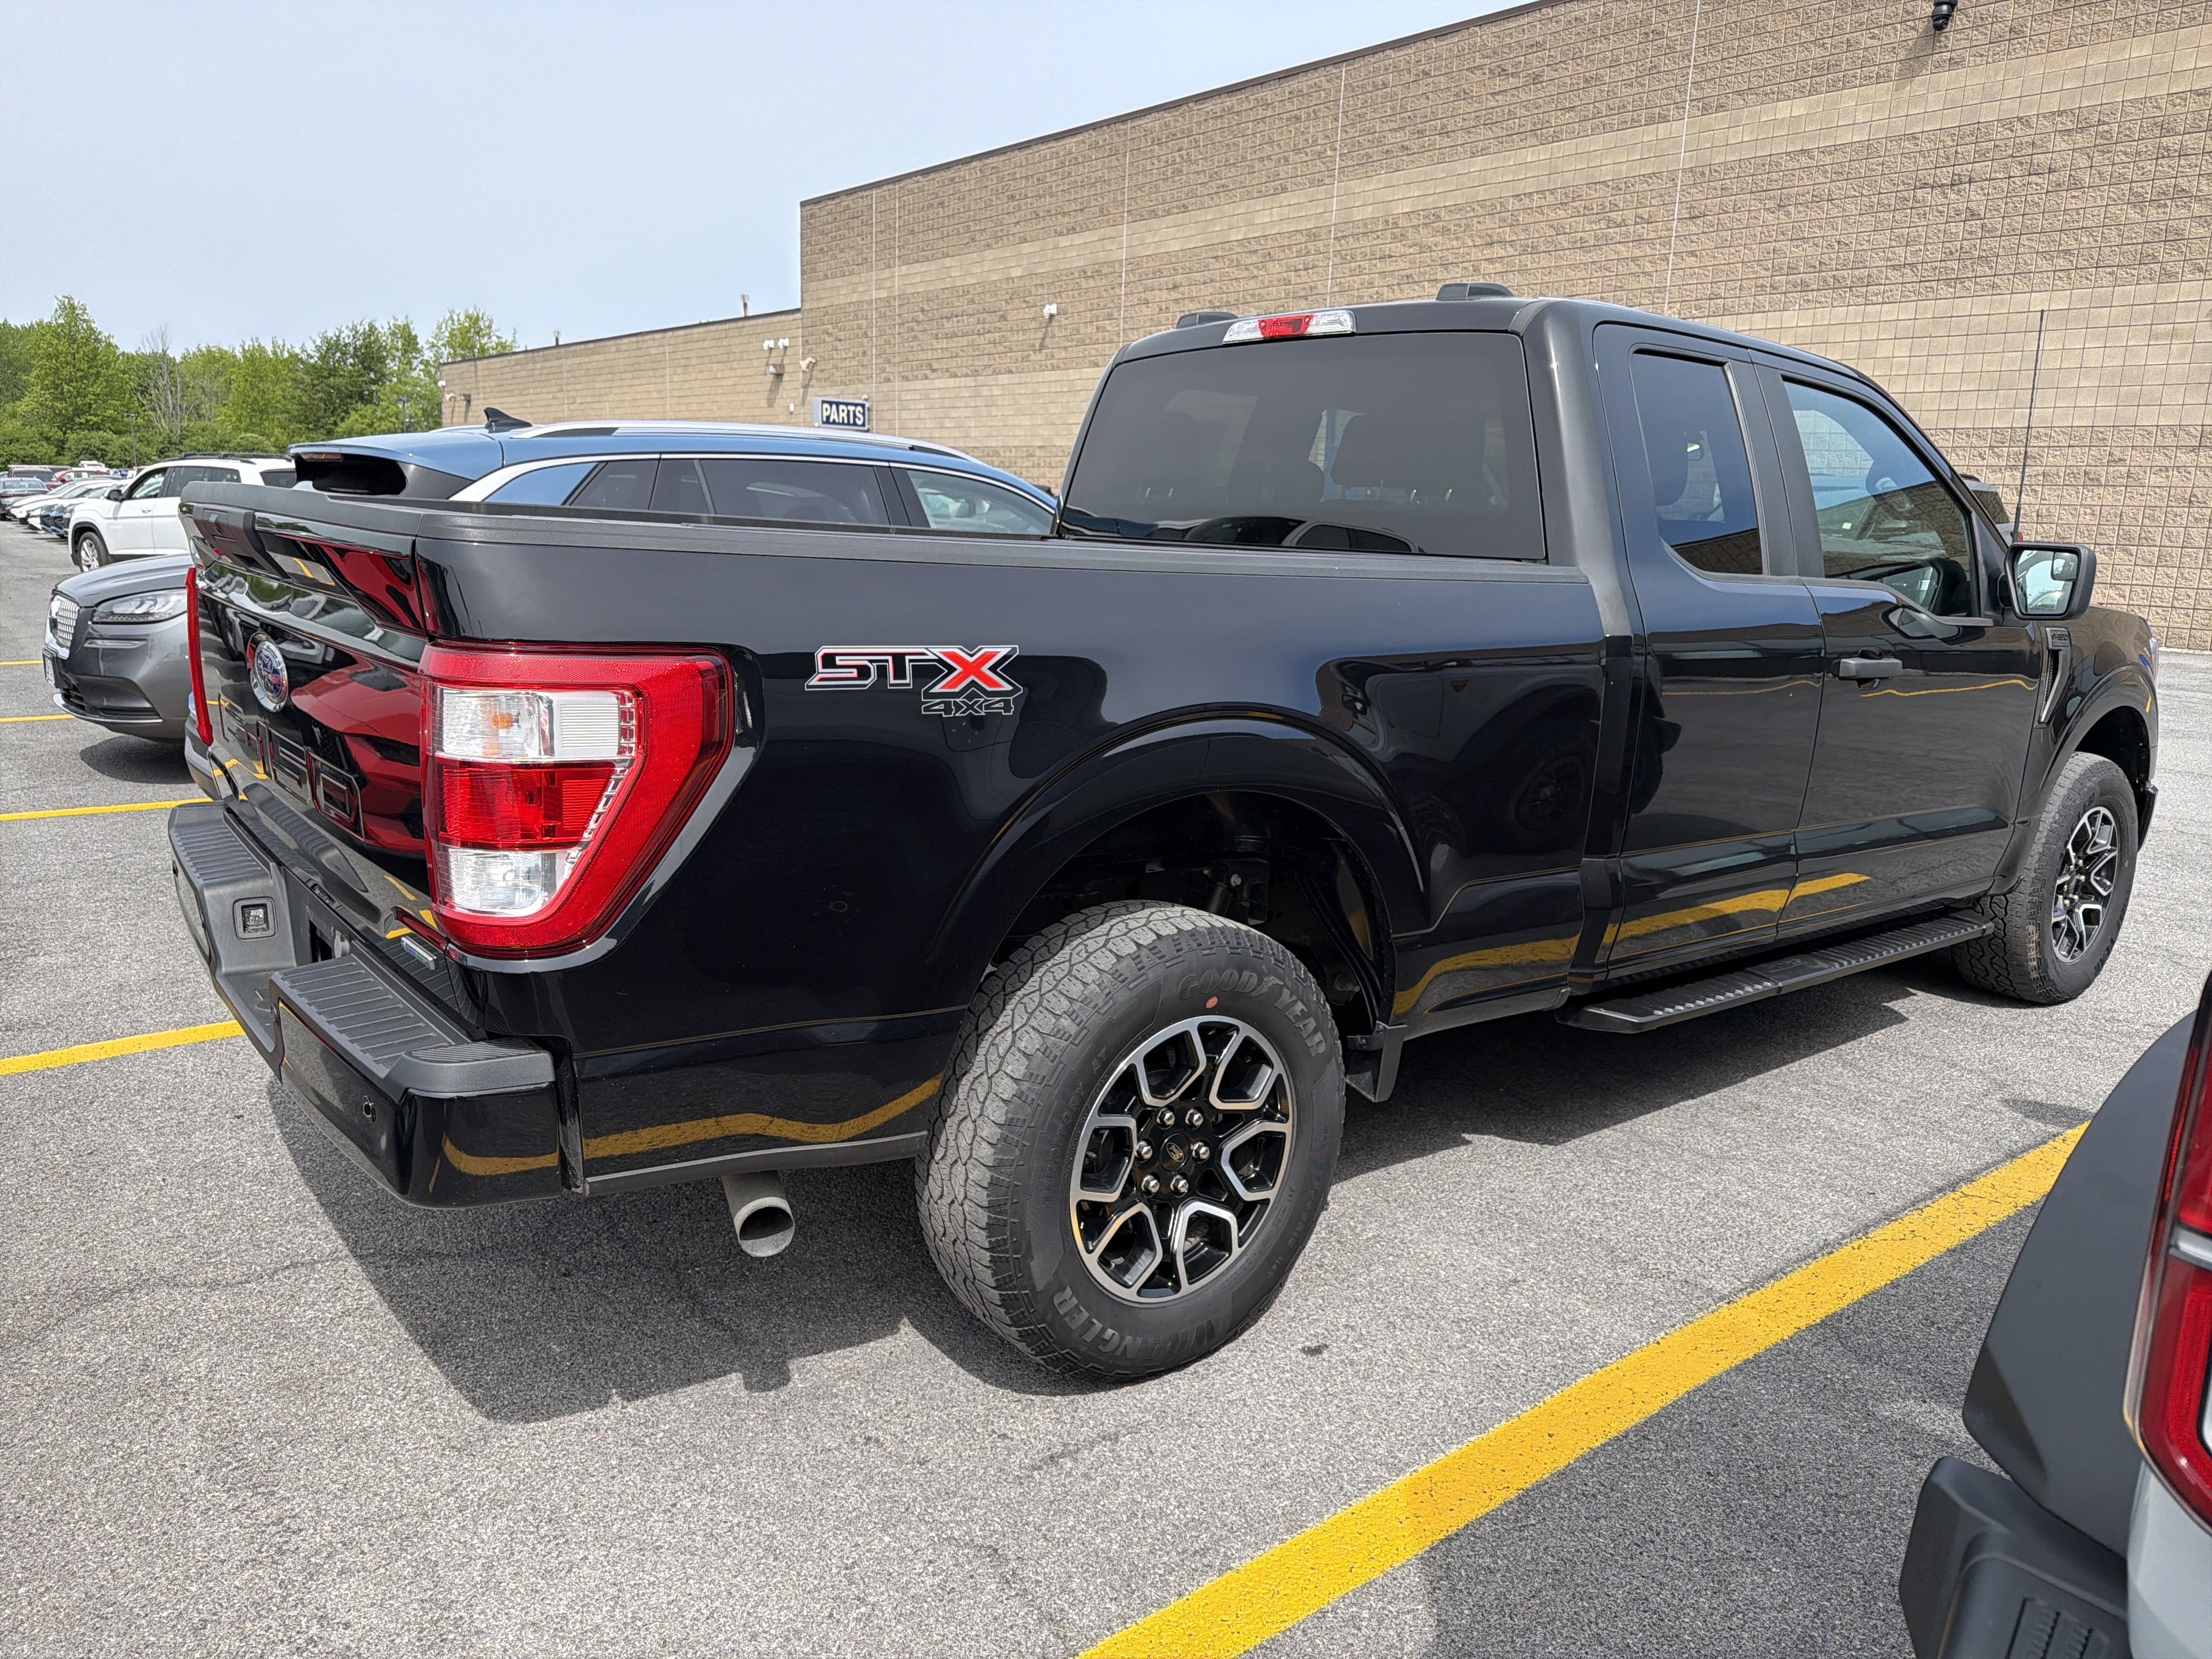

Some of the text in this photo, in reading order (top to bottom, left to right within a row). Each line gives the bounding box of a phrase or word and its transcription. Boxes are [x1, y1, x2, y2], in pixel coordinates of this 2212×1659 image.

[823, 403, 864, 425] PARTS
[805, 645, 1023, 701] STX
[1177, 969, 1327, 1058] GOODYEAR
[1168, 1144, 1183, 1160] Ford
